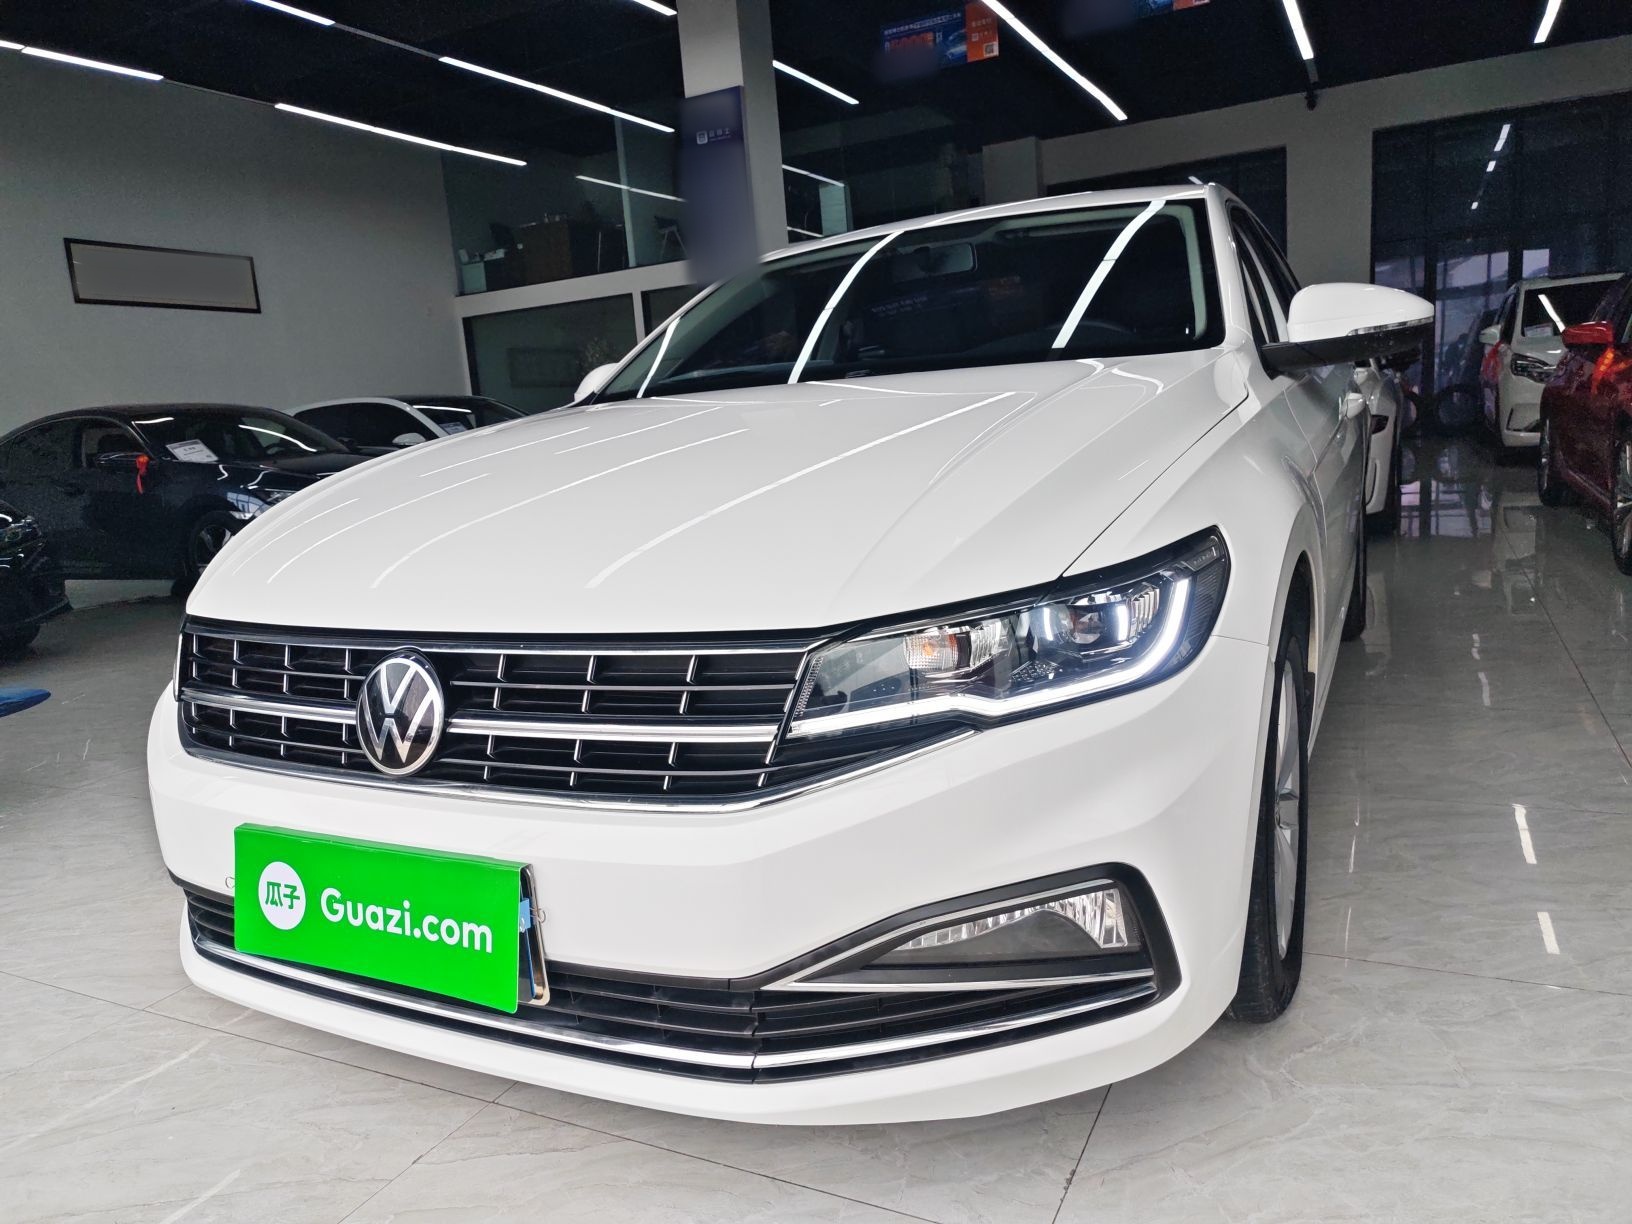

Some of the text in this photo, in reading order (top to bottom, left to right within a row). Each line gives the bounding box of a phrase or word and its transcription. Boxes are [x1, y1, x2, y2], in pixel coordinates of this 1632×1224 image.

[361, 660, 437, 764] VW
[265, 880, 301, 910] 瓜子
[320, 887, 493, 954] Guazi.com
